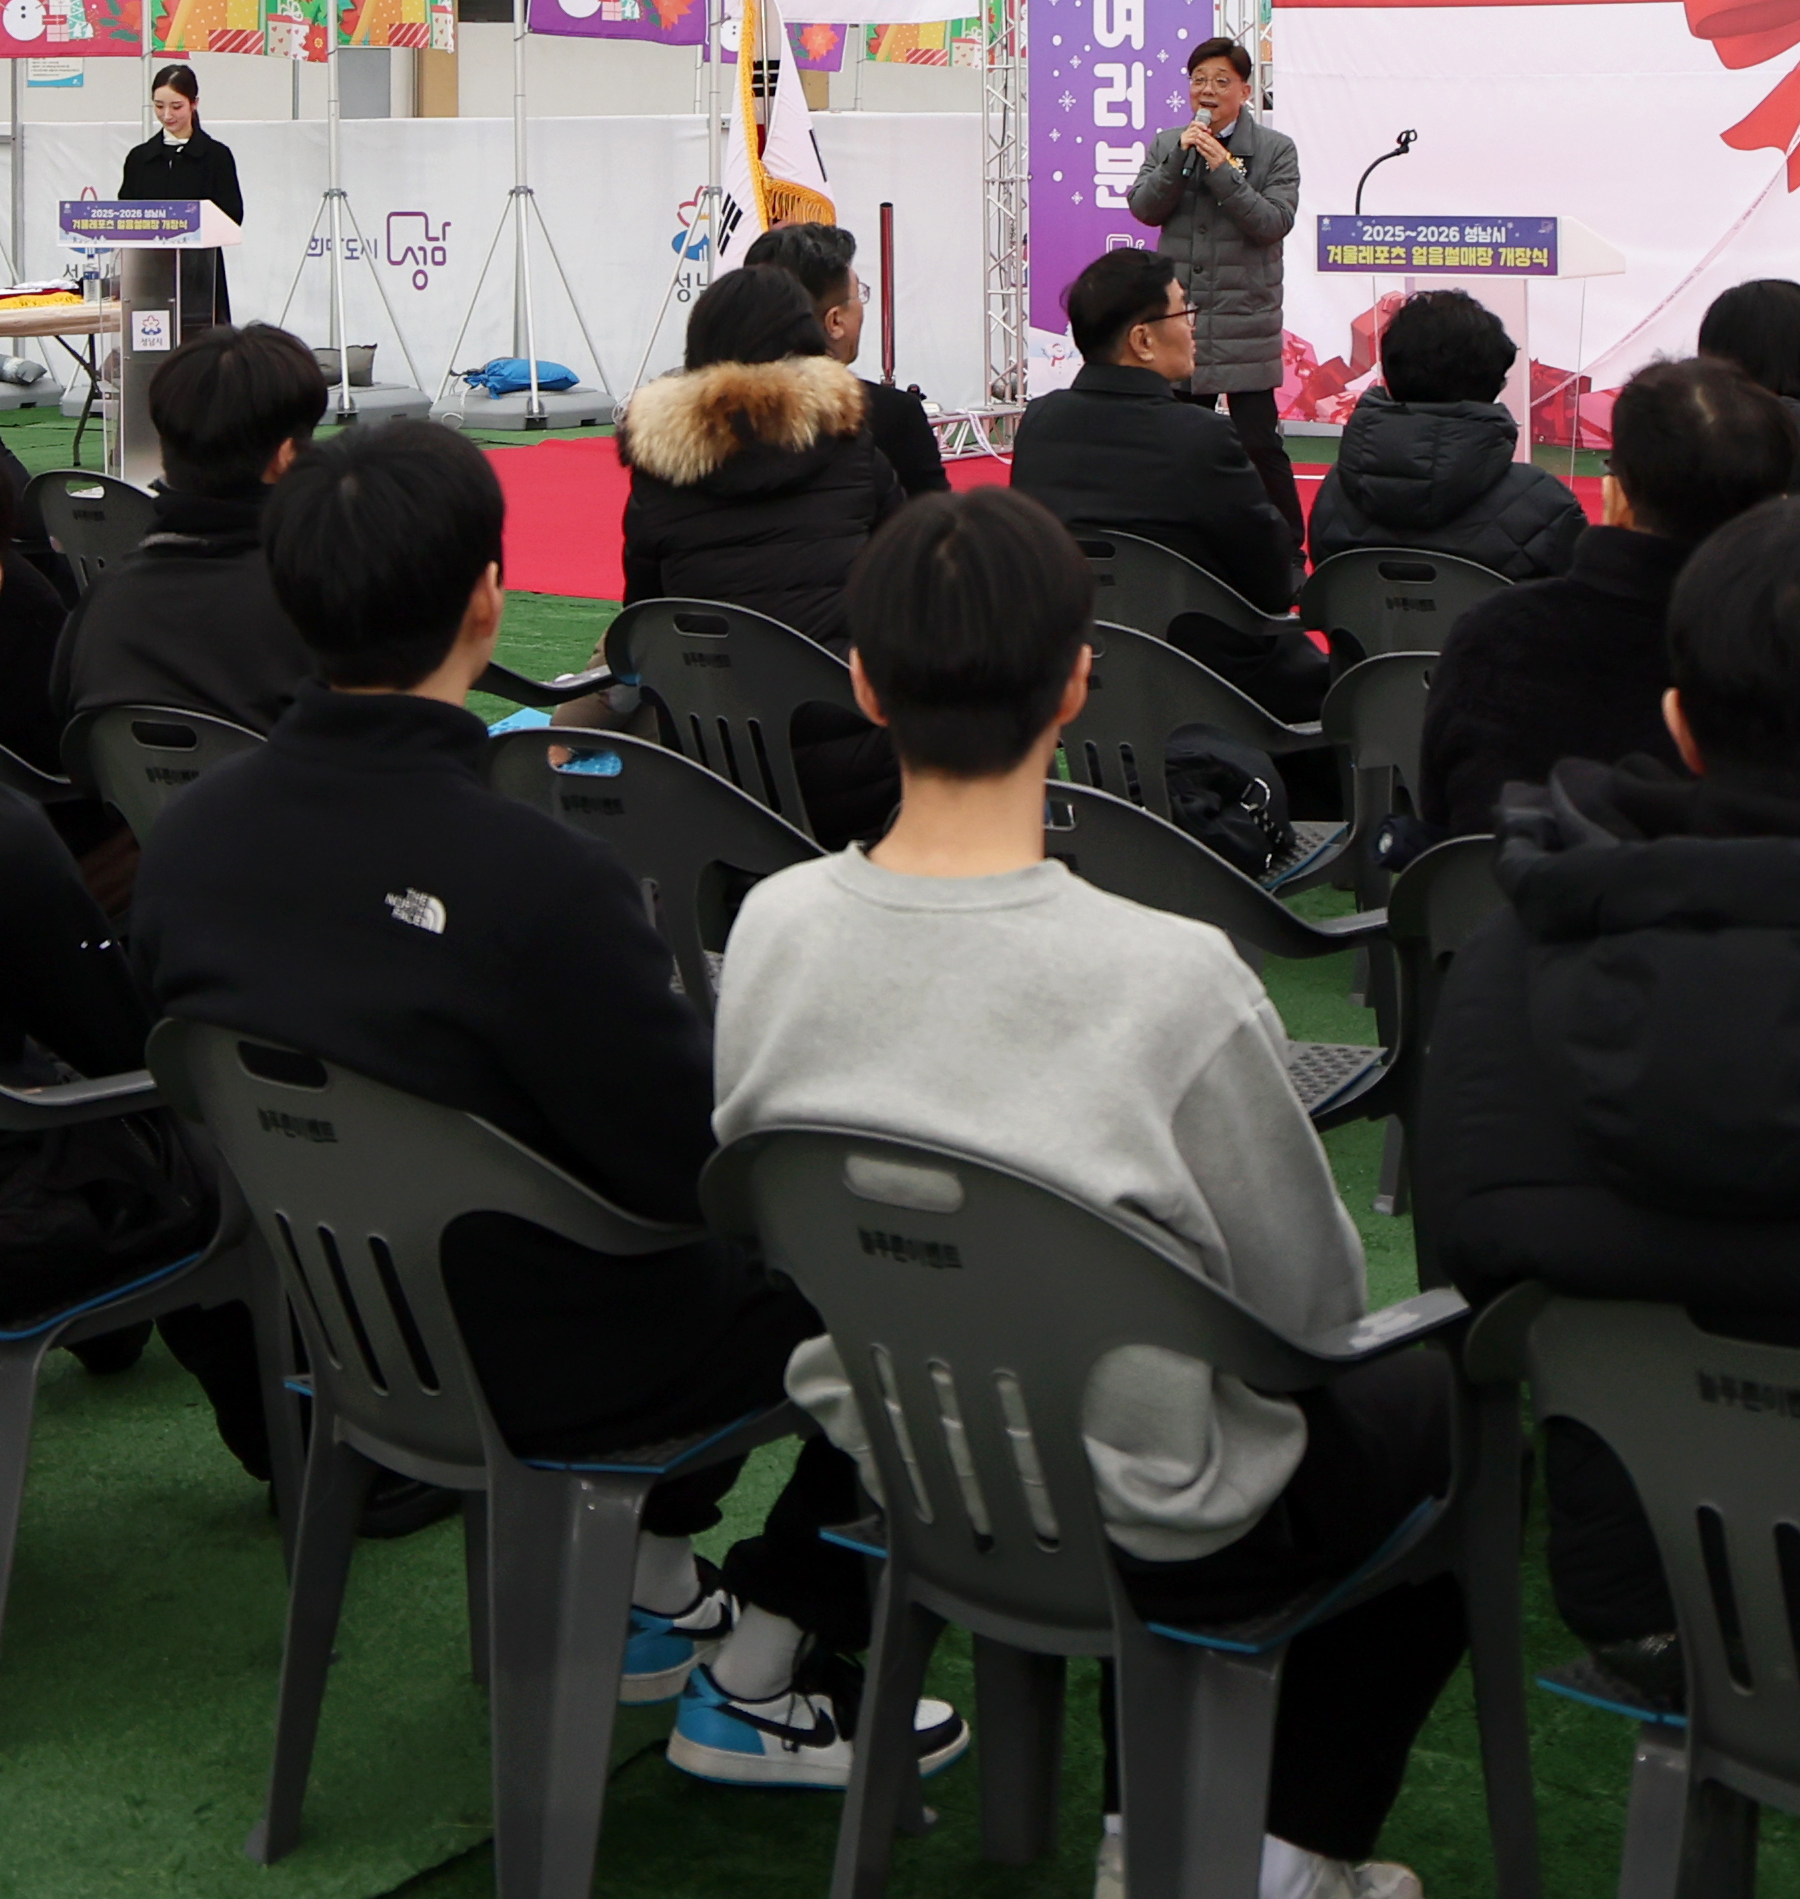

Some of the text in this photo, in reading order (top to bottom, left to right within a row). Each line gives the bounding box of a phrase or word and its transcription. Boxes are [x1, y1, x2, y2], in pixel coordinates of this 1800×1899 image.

[1362, 225, 1506, 243] 2025~2026 성남시
[1326, 245, 1549, 268] 겨울레포츠 얼음썰매장 개장식
[140, 337, 163, 347] 성남시
